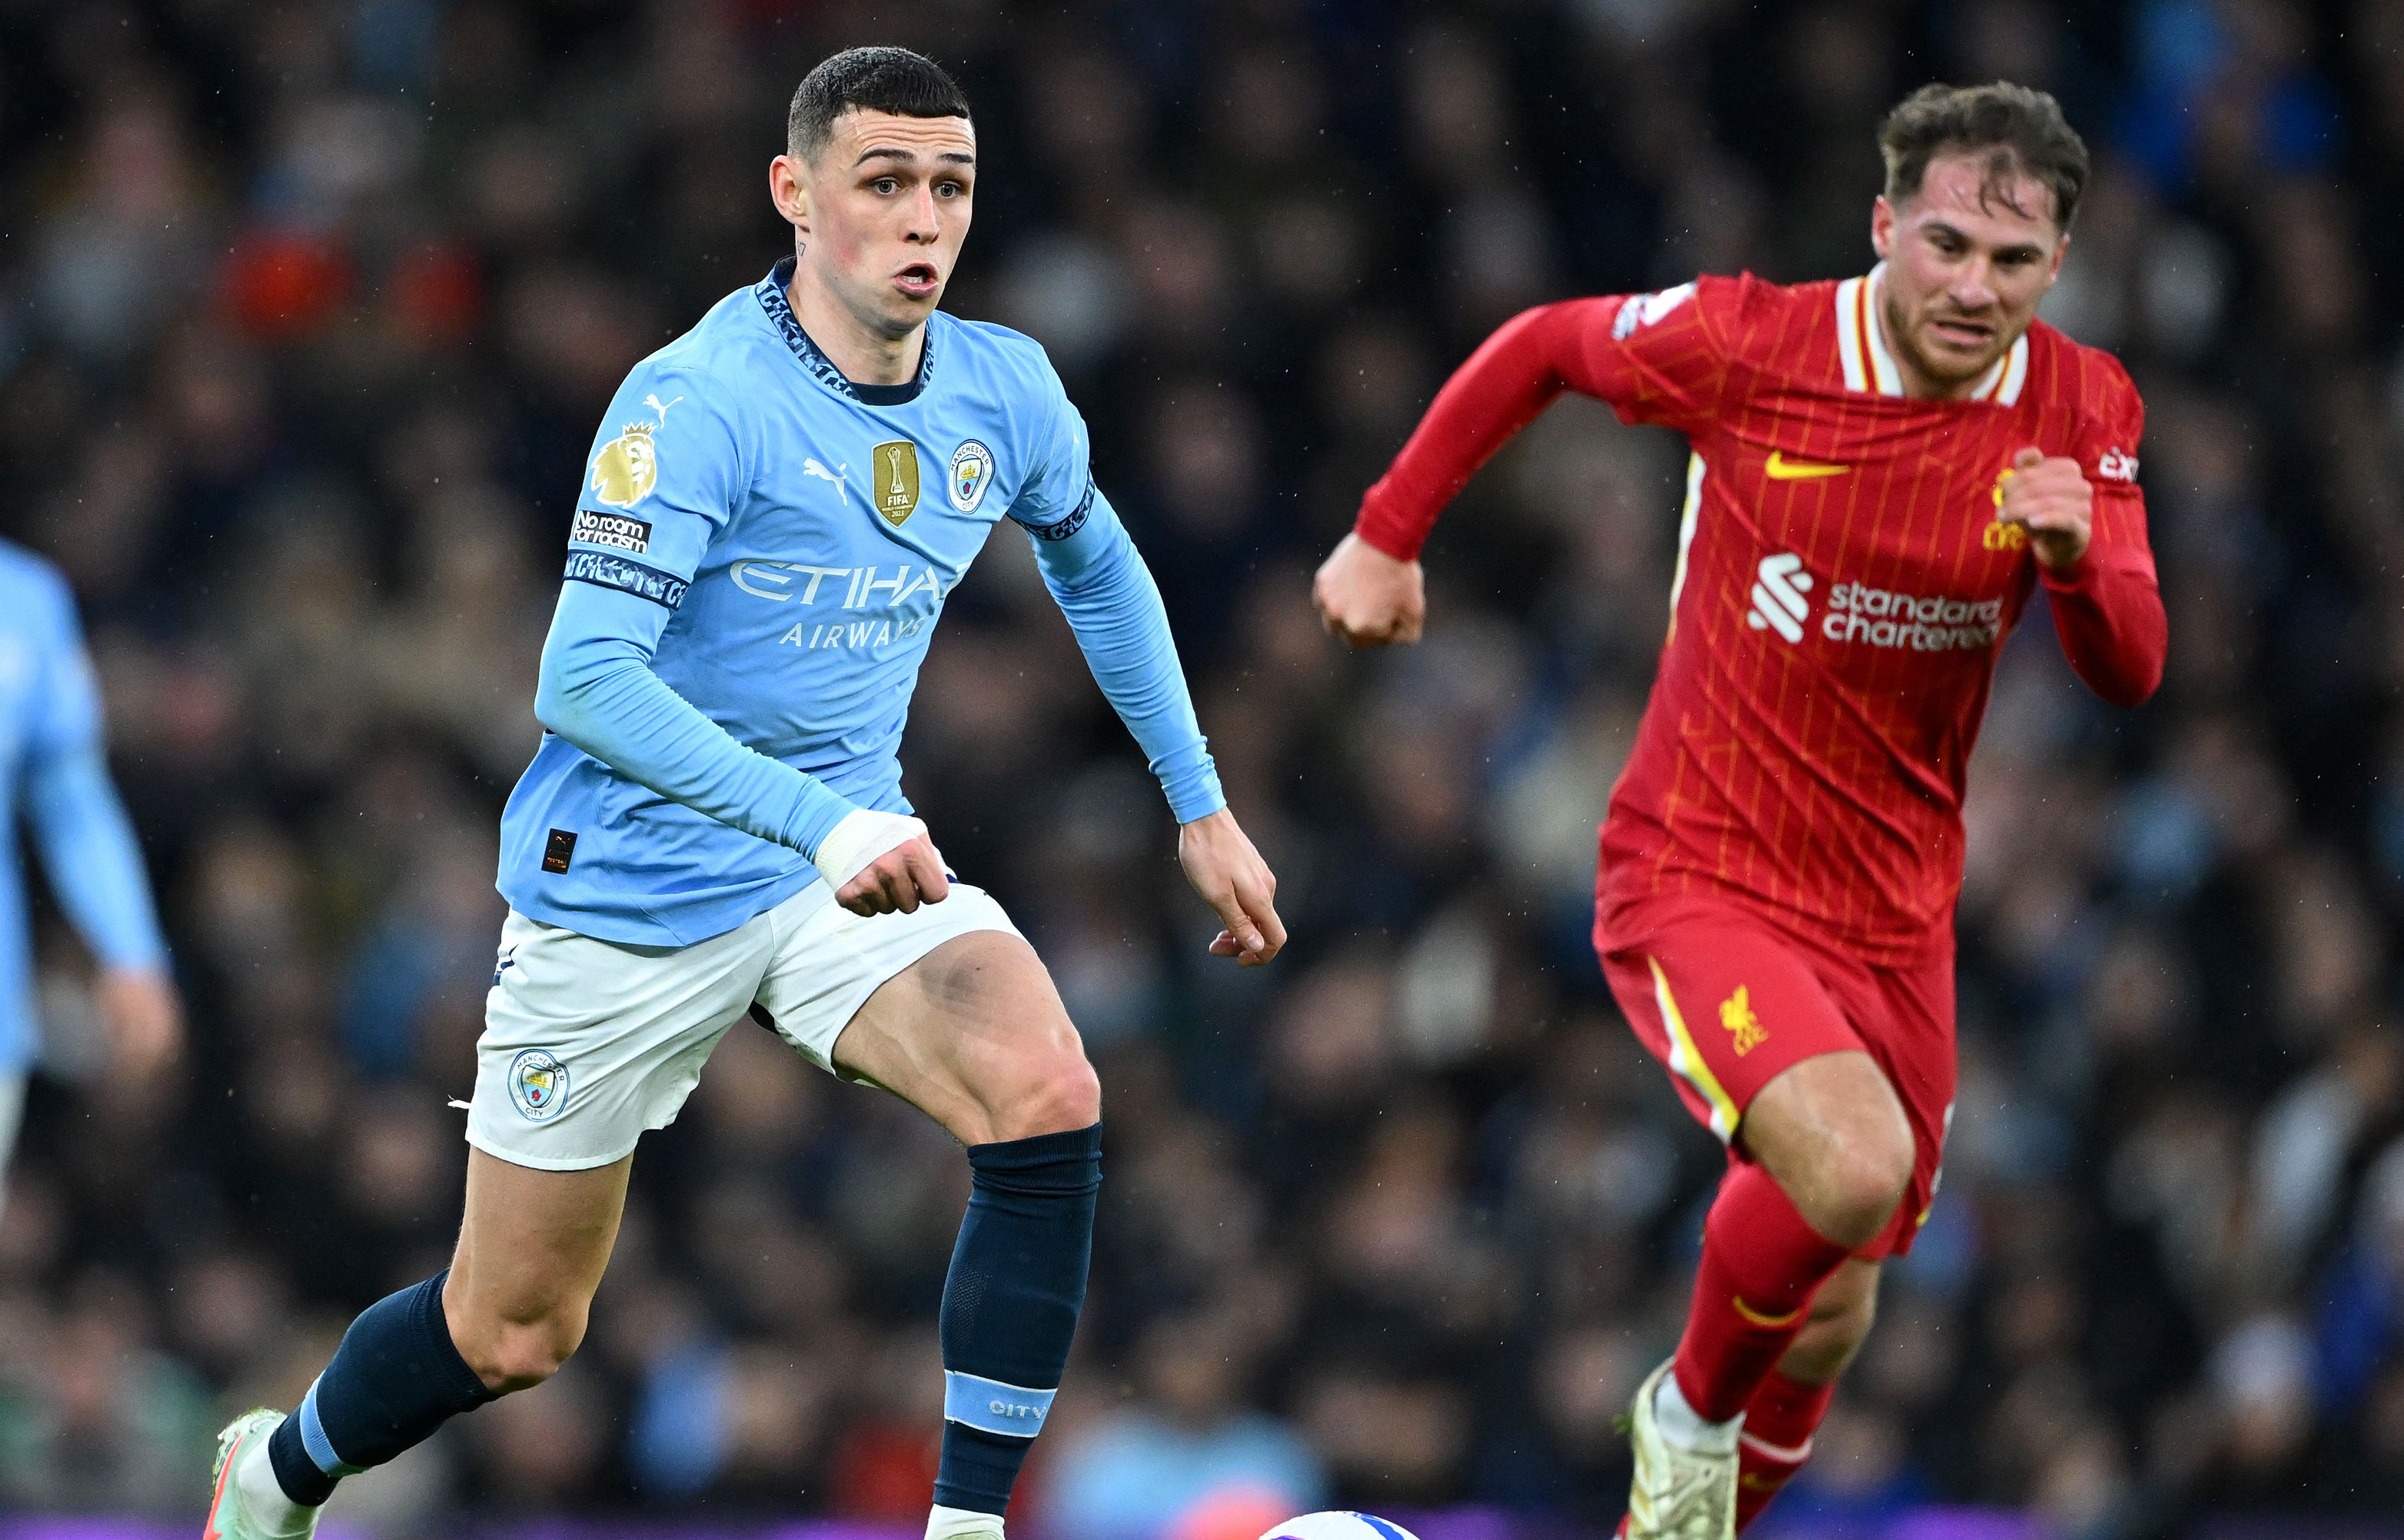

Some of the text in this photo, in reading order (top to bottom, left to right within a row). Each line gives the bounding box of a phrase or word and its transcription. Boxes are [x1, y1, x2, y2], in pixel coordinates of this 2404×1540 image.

[951, 446, 989, 471] MANCHESTER
[887, 494, 909, 506] FIFA
[962, 501, 973, 509] CITY
[575, 510, 643, 538] No room
[573, 524, 647, 554] for racism
[1828, 580, 2004, 626] standard
[779, 616, 925, 648] AIRWAYS
[517, 1055, 565, 1082] MANCHESTER
[525, 1107, 544, 1117] CITY
[989, 1400, 1046, 1419] CITY
